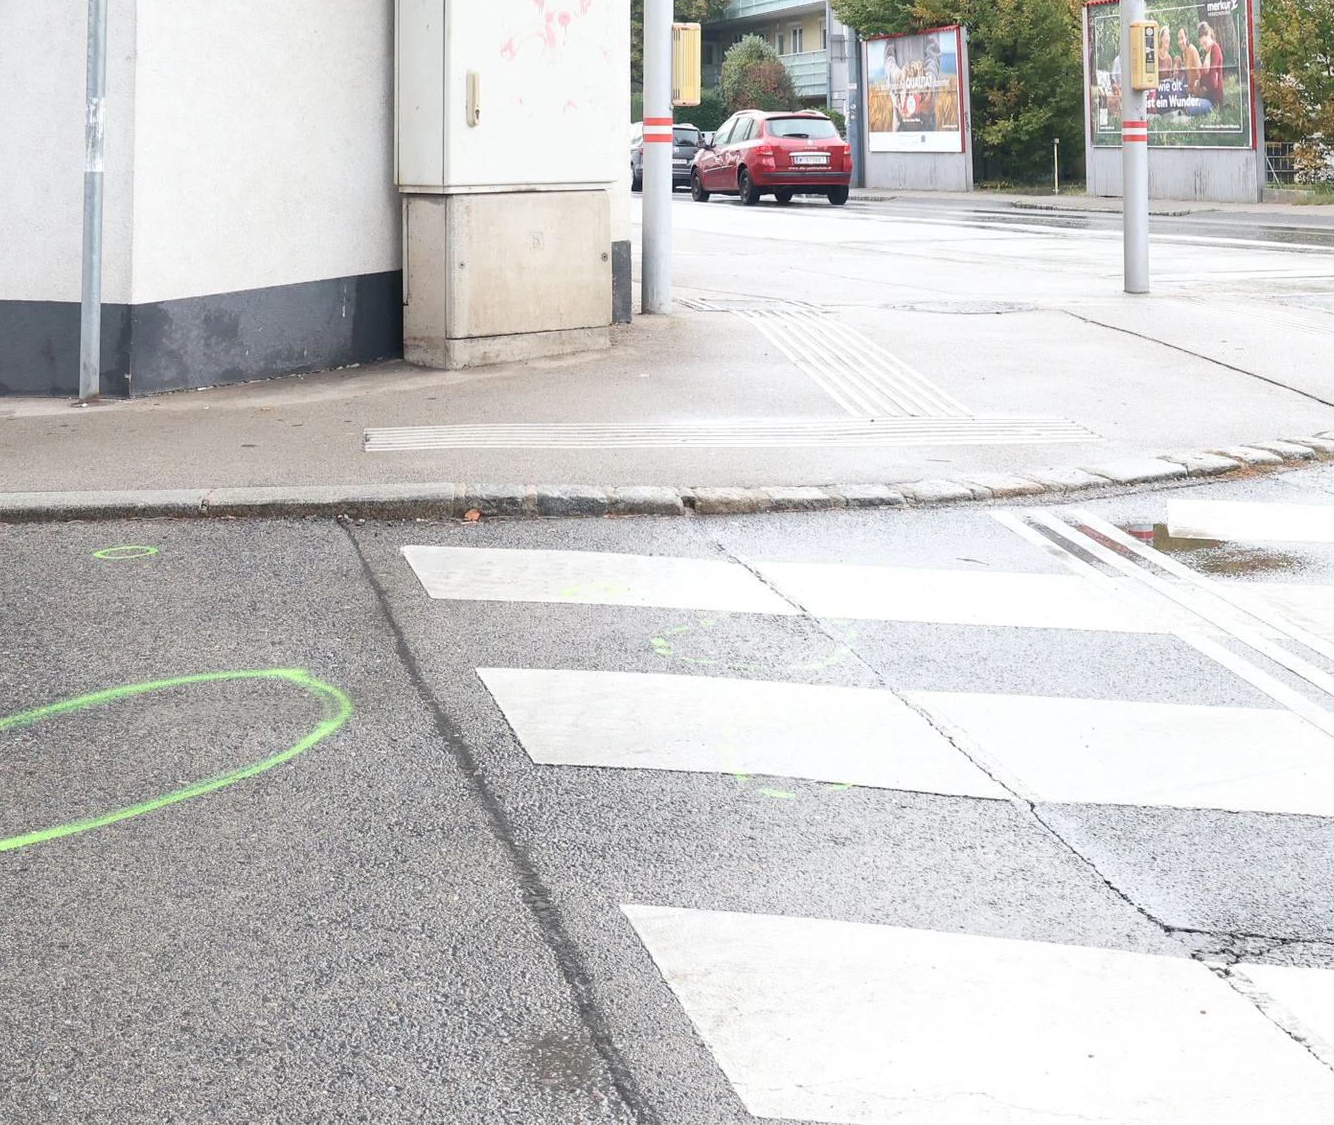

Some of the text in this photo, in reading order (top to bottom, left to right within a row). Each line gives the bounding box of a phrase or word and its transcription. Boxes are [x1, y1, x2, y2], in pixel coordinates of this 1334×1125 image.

[1207, 0, 1231, 12] merkur
[1172, 78, 1183, 91] alt
[1156, 95, 1168, 107] ein
[1169, 93, 1201, 107] Wunder.
